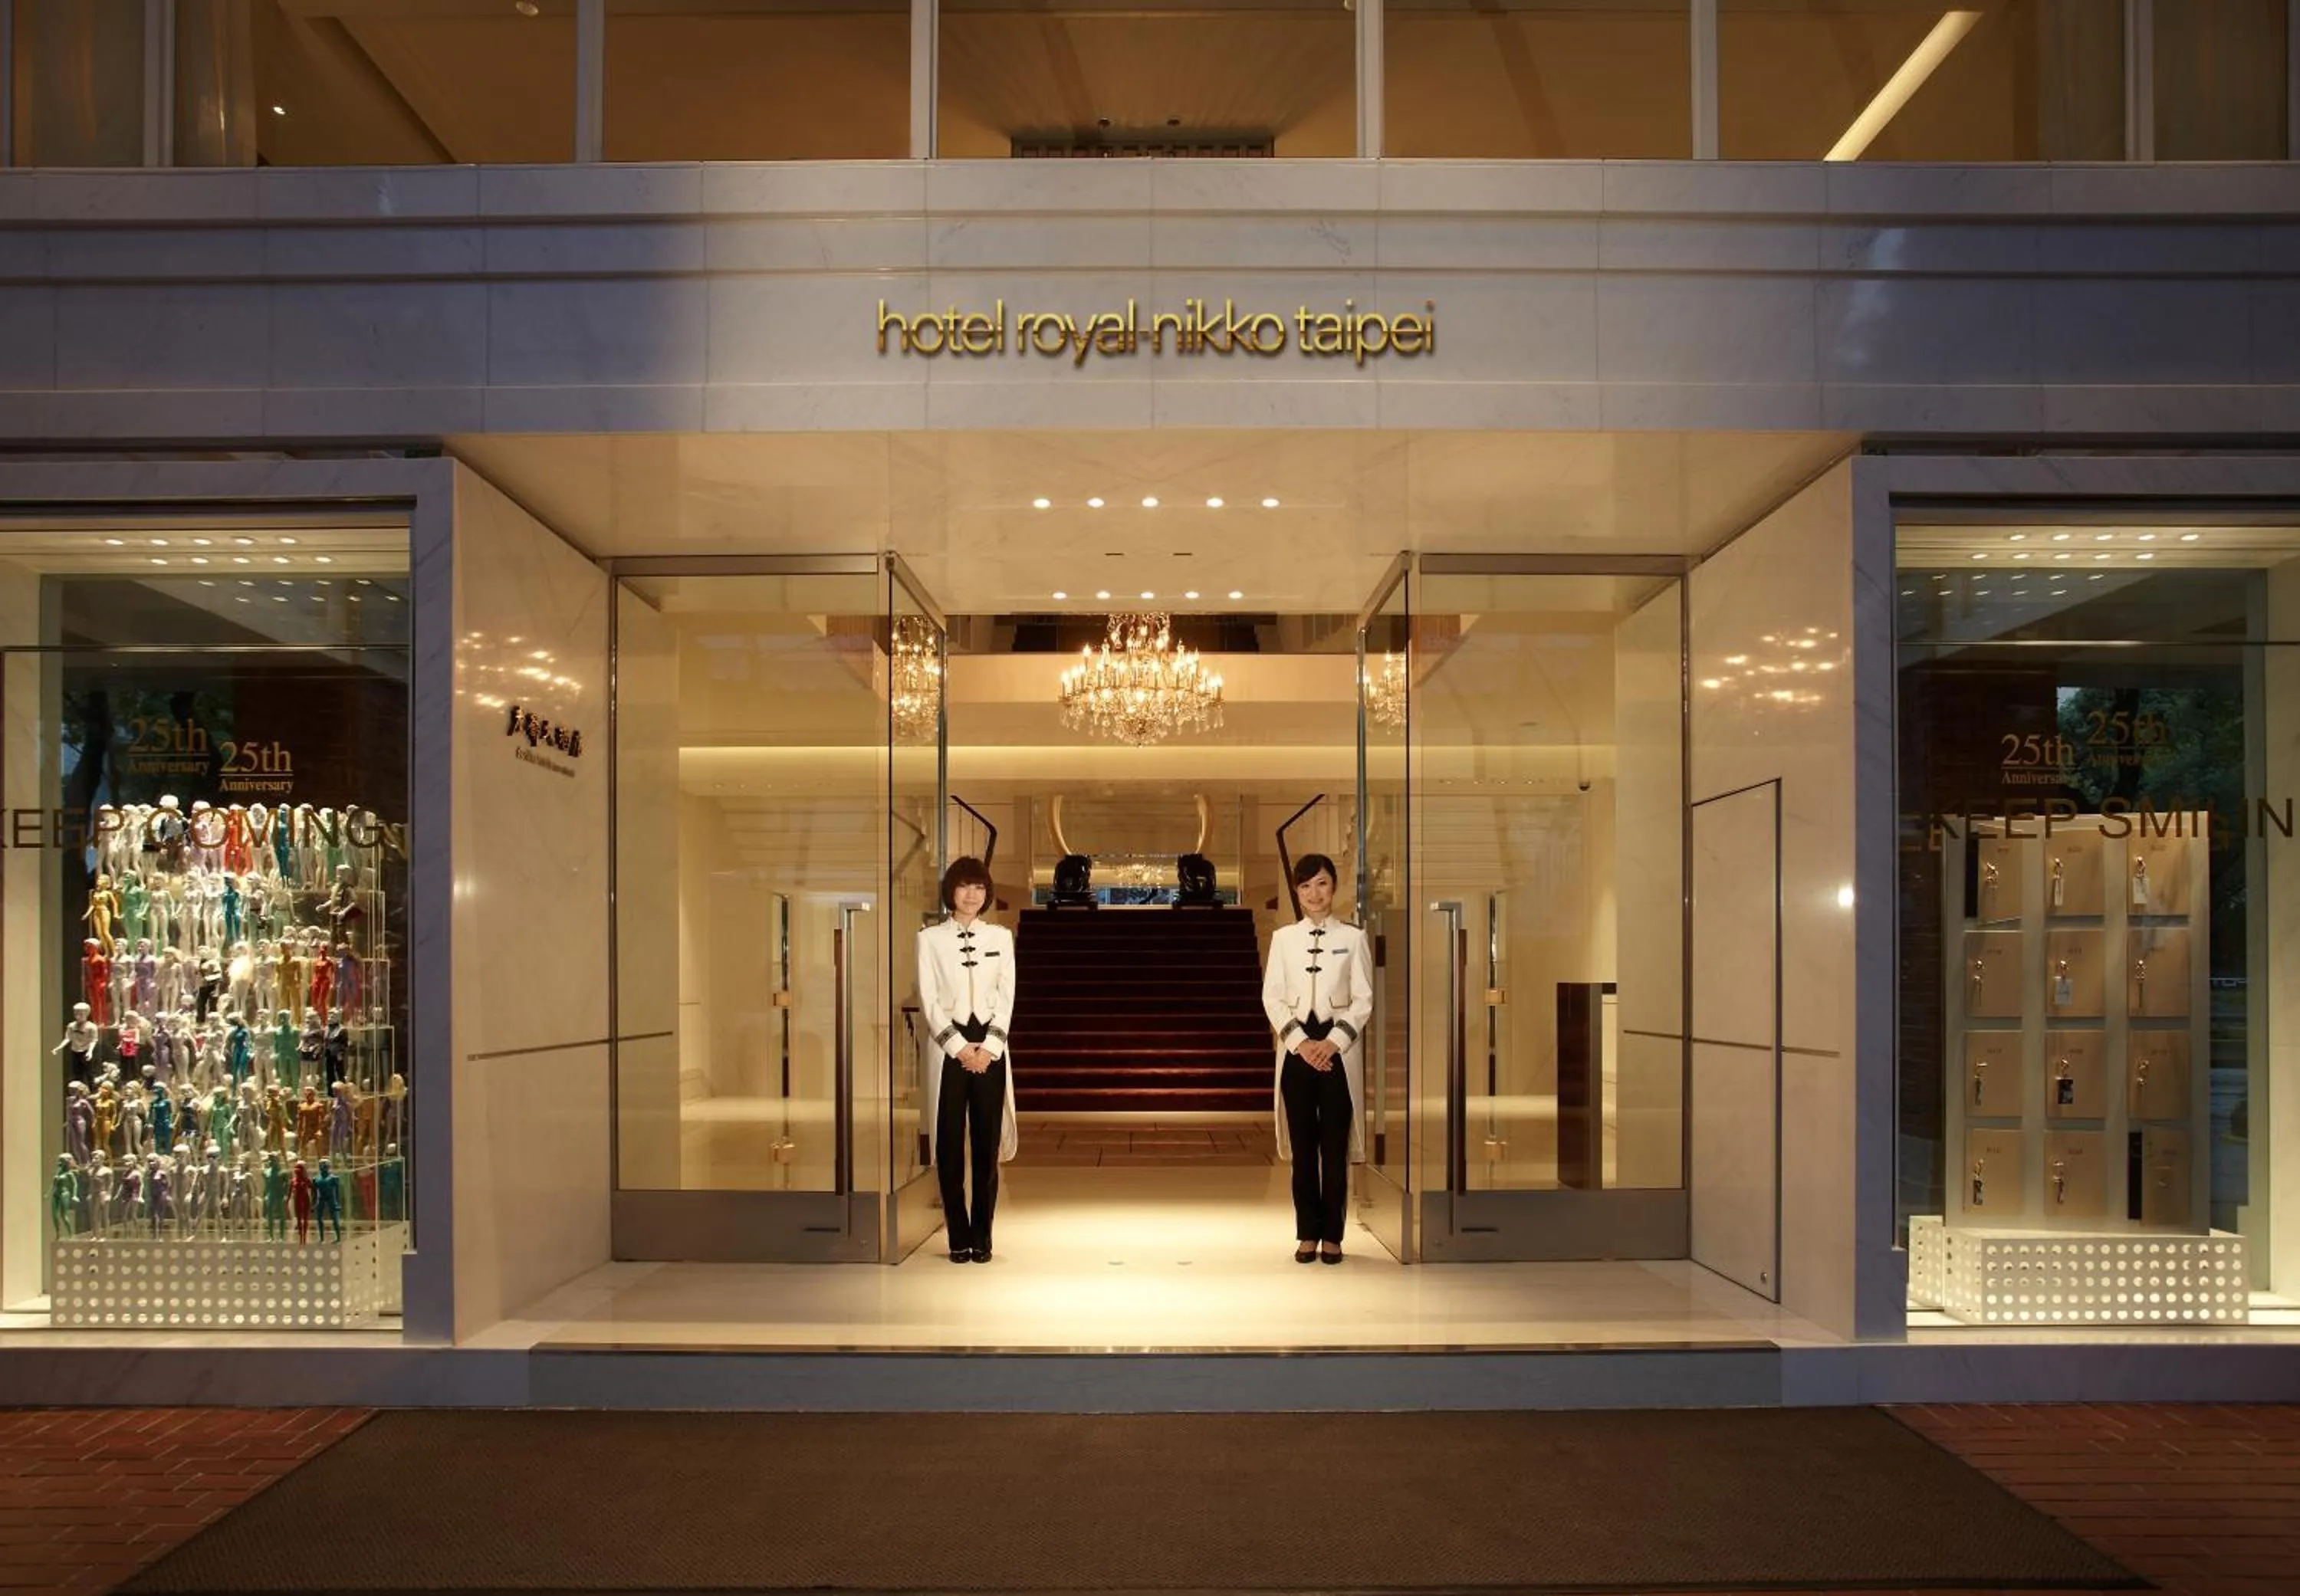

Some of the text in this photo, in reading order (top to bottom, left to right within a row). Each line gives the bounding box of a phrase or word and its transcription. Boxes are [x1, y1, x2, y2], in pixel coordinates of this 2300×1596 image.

[877, 298, 1004, 353] hotel
[1293, 298, 1434, 366] taipei
[129, 718, 207, 753] 25th
[2086, 710, 2168, 745] 25th
[219, 741, 294, 773] 25th
[2001, 734, 2077, 766] 25th
[219, 778, 294, 793] Anniversary
[0, 807, 386, 849] EEP COMING
